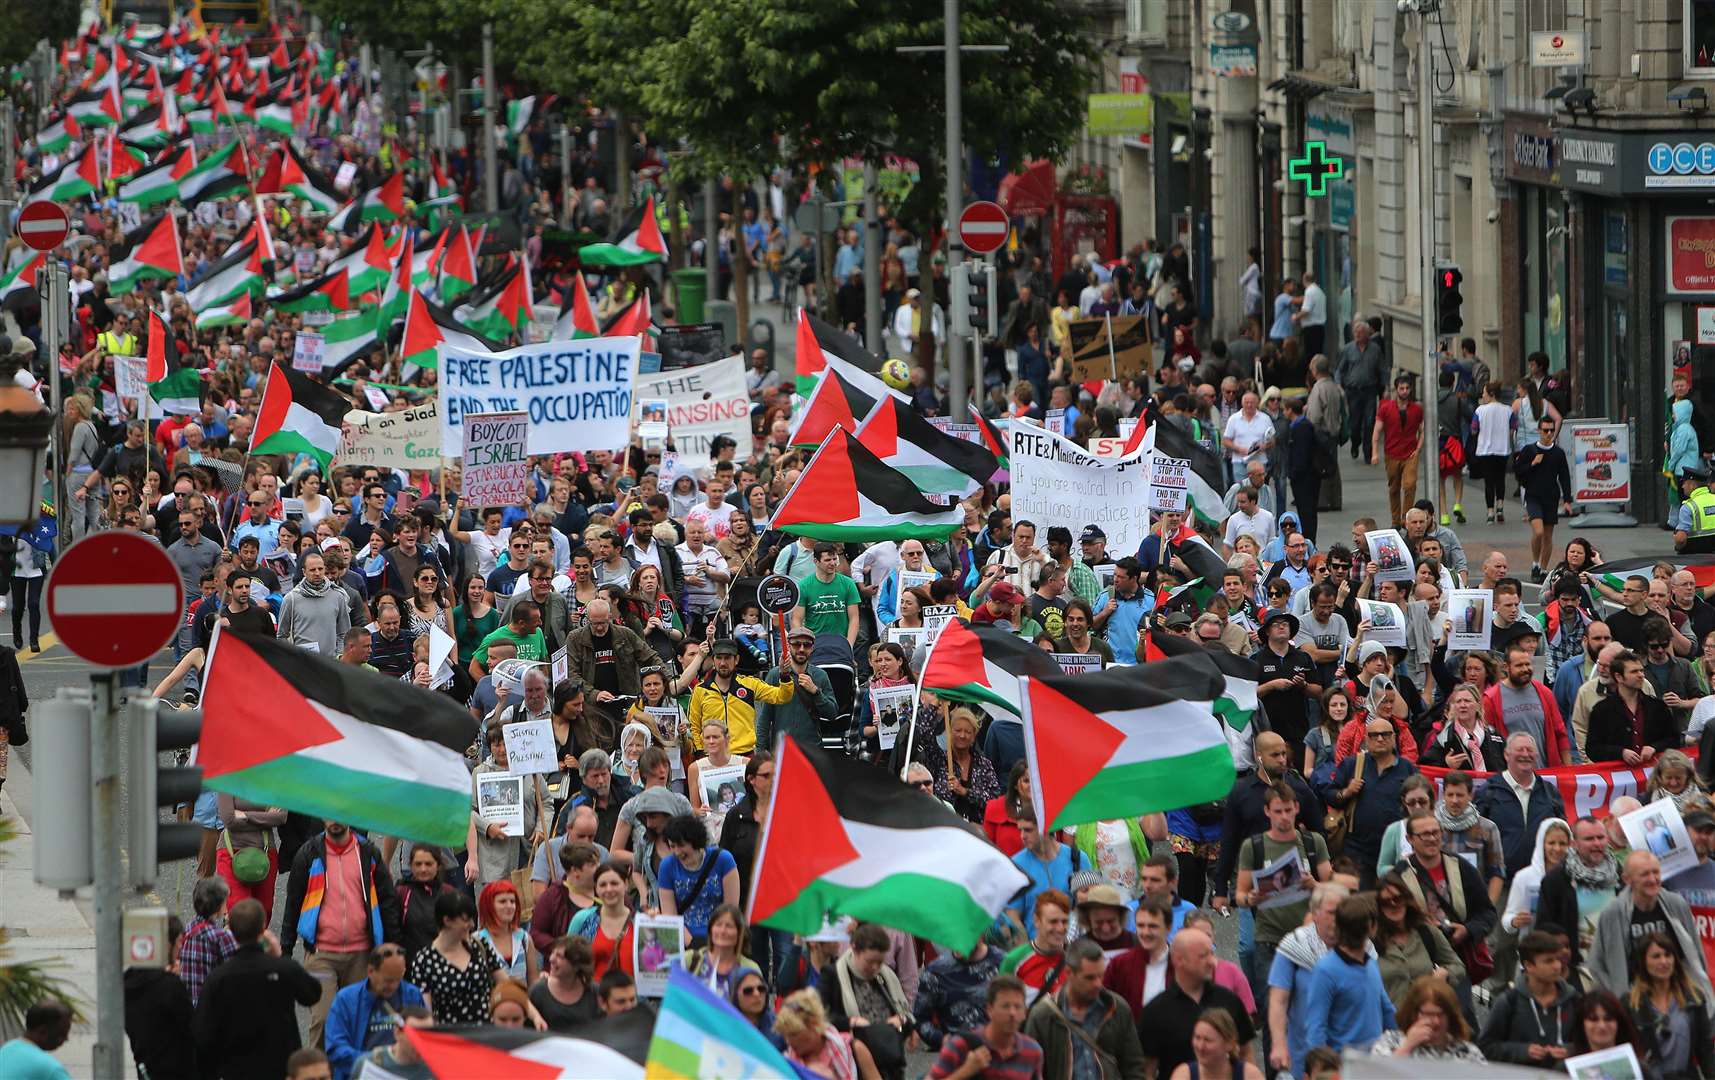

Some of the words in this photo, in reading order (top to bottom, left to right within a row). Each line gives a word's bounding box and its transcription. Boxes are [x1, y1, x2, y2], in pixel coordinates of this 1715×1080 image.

[446, 358, 491, 387] FREE
[650, 375, 703, 396] THE
[380, 420, 395, 428] an
[404, 403, 437, 422] Slad
[448, 395, 484, 425] END
[667, 399, 749, 427] ANSING
[471, 423, 528, 442] BOYCOTT
[384, 446, 393, 455] in
[1015, 432, 1043, 457] RTE
[468, 443, 527, 466] ISRAEL
[1154, 458, 1189, 467] GAZA
[465, 464, 527, 486] STARBUCKS
[1158, 465, 1173, 476] STOP
[1174, 467, 1185, 477] THE
[469, 480, 525, 497] COCACOLA
[1116, 477, 1133, 496] in
[1154, 475, 1186, 486] SLAUGHTER
[1156, 489, 1168, 499] END
[1170, 490, 1180, 500] THE
[1159, 498, 1176, 508] SIEGE
[924, 606, 957, 617] GAZA
[929, 617, 940, 629] STOP
[509, 751, 546, 763] PALESTINE
